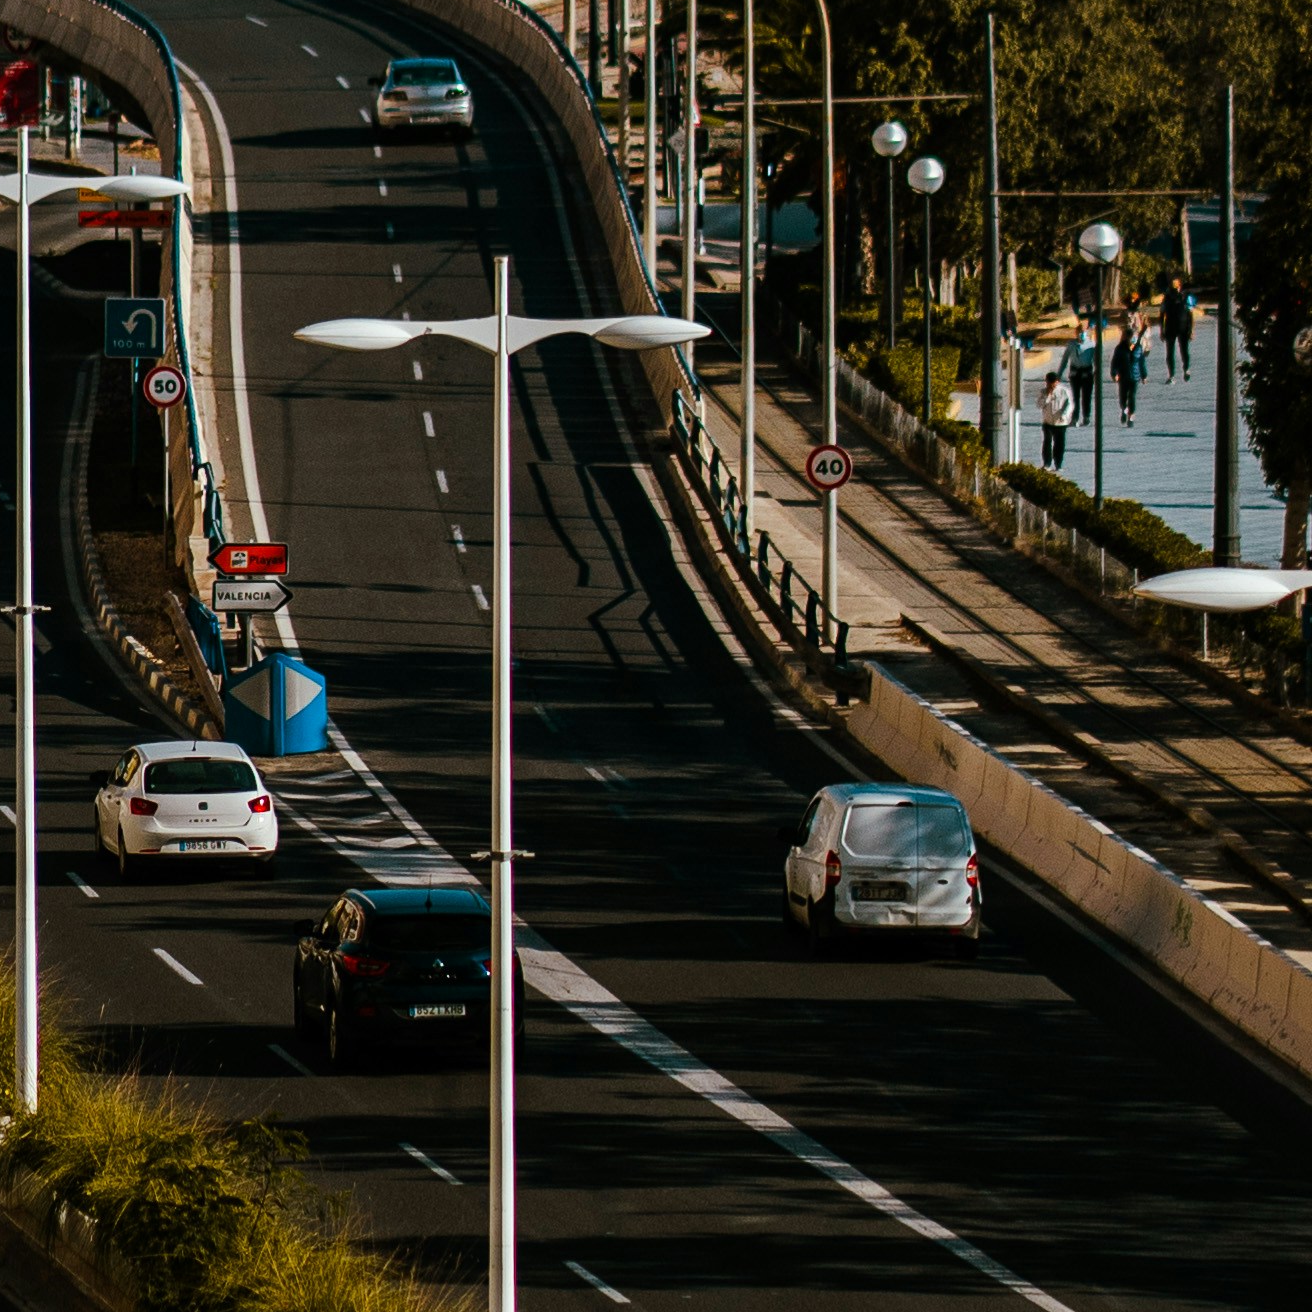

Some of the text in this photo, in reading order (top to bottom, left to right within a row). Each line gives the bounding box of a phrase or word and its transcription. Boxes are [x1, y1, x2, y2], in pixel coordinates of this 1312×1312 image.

[113, 340, 133, 348] 100
[154, 379, 177, 394] 50
[815, 459, 844, 475] 40
[250, 556, 284, 566] Playas
[217, 591, 272, 601] VALENCIA
